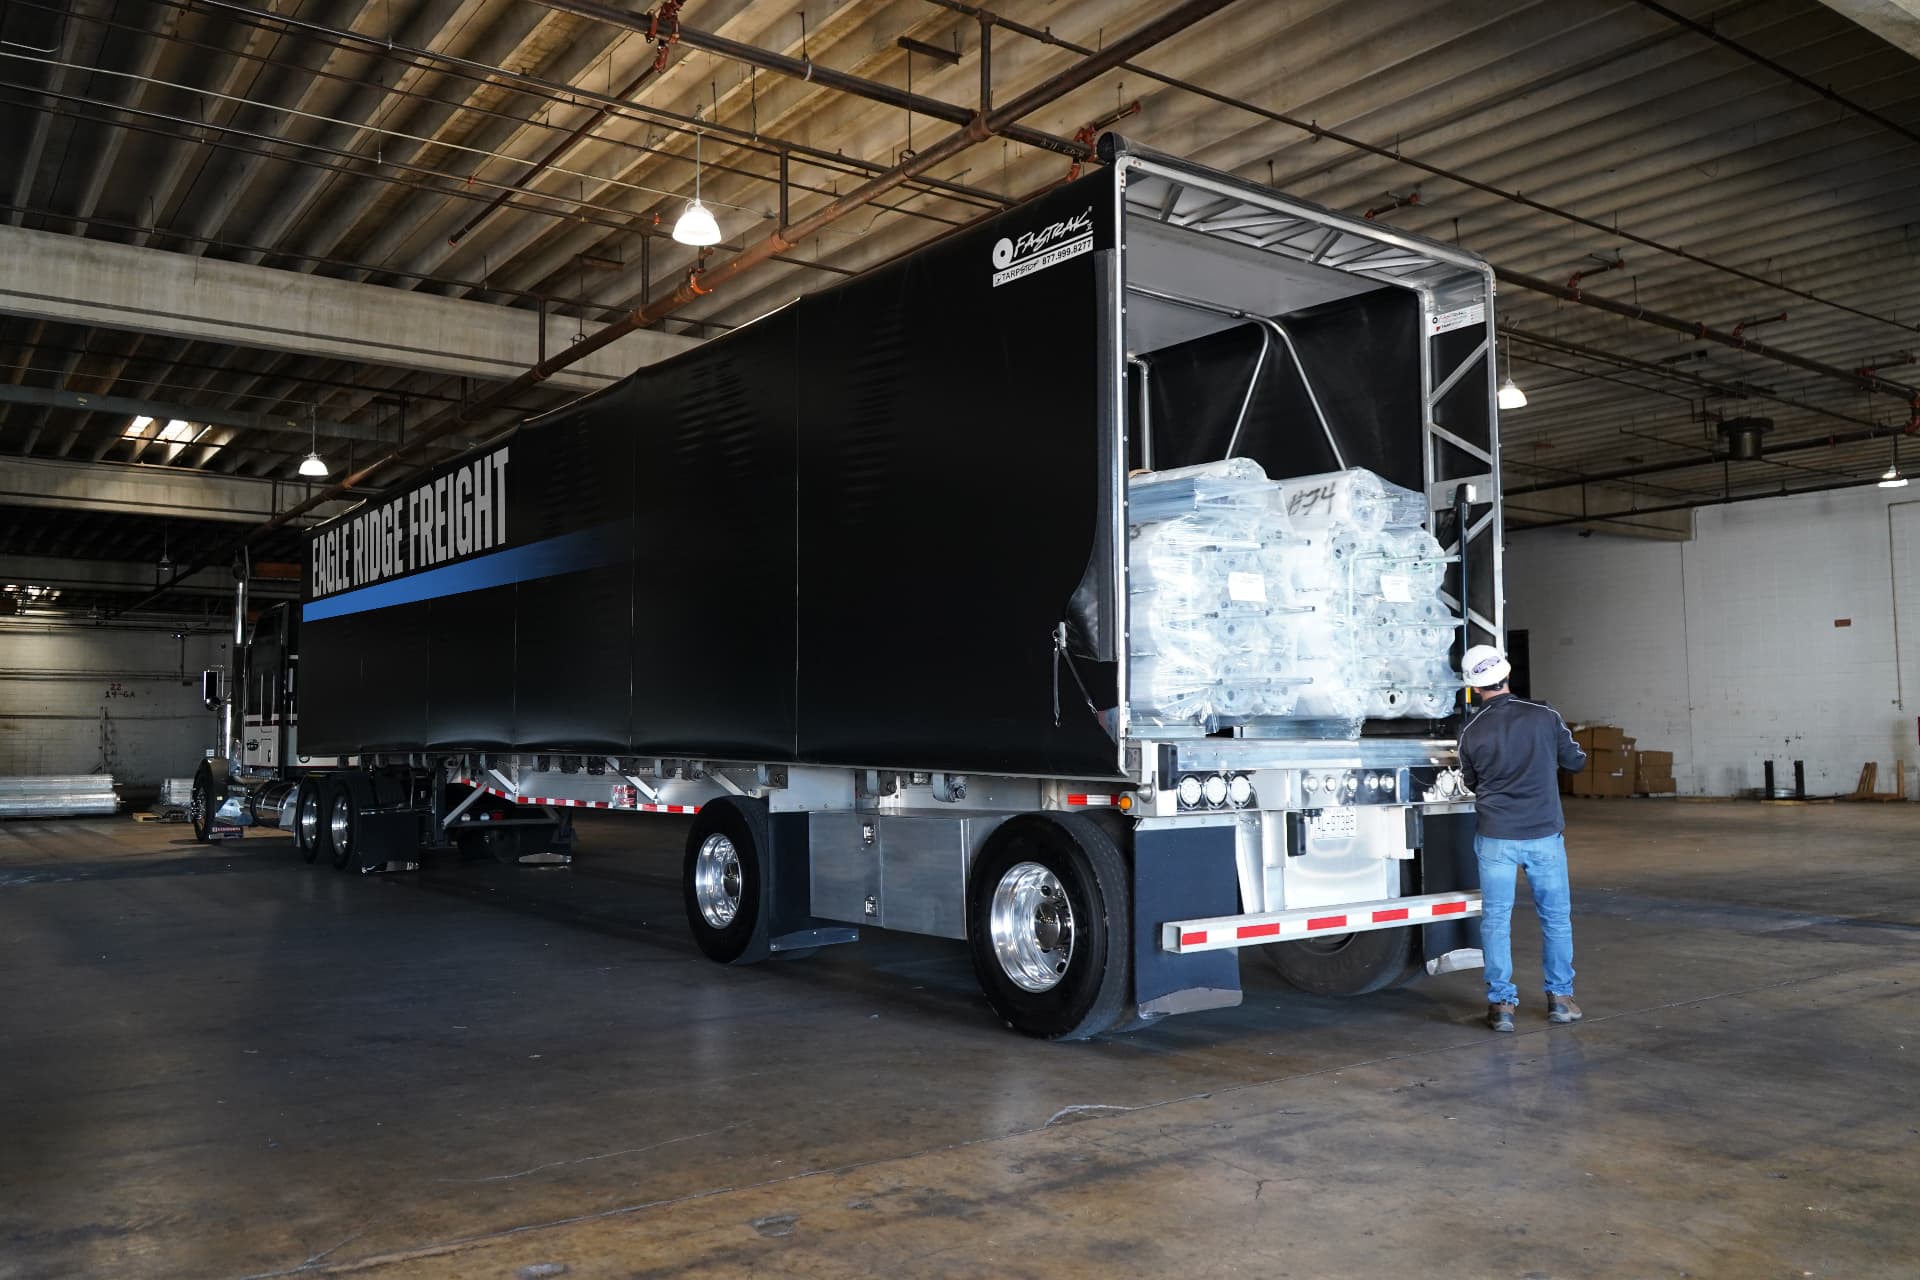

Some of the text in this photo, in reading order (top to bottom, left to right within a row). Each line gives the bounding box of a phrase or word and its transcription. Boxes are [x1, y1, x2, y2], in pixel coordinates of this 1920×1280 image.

[1013, 210, 1091, 258] FASTRAK
[1042, 239, 1092, 265] 877.999.8277
[312, 446, 509, 598] EAGLE RIDGE FREIGHT
